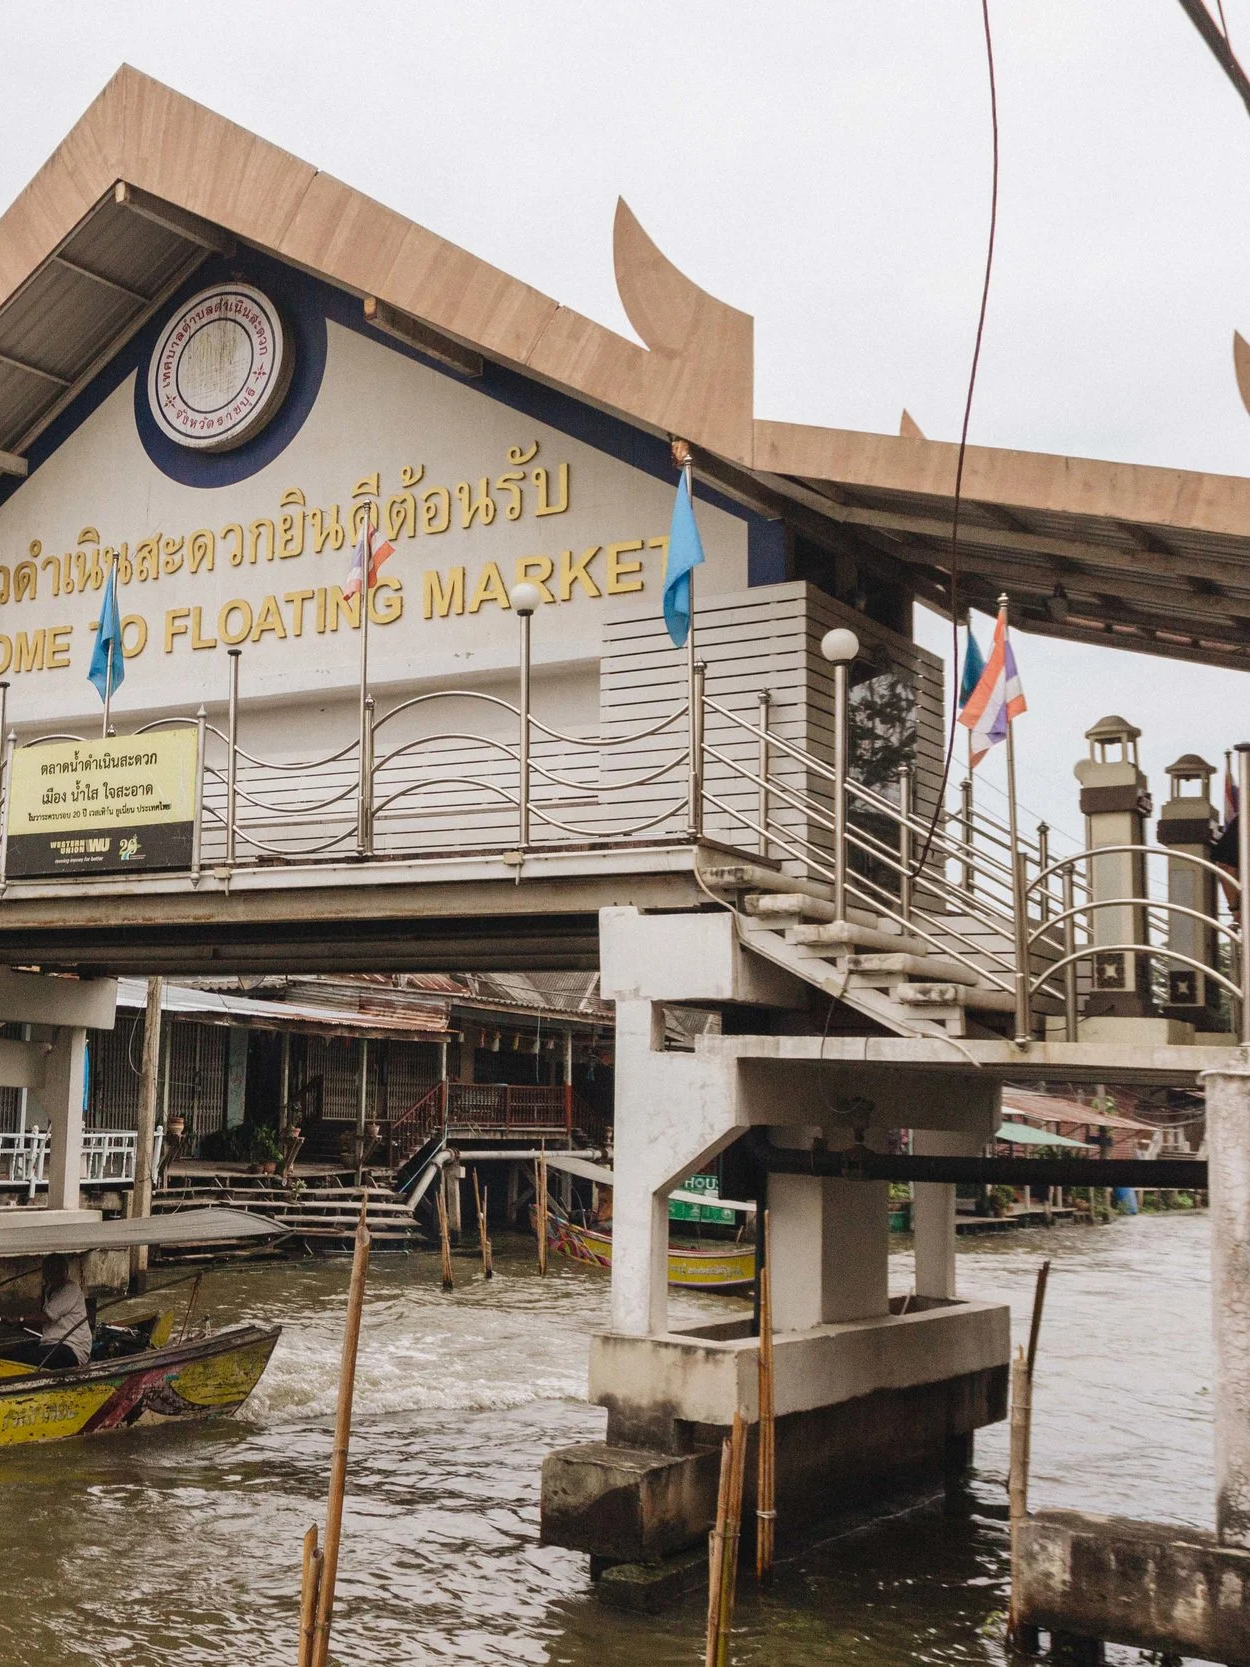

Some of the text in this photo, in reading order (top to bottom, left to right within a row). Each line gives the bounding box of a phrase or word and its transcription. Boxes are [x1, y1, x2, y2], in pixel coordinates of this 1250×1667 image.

[163, 576, 404, 653] FLOATING
[40, 750, 157, 775] ตลาดน้ำดำเนินสะดวก
[41, 780, 154, 805] เมือง น้ำใส ใจสะอาด
[72, 811, 81, 819] 20
[50, 839, 86, 849] WESTERN
[60, 846, 86, 855] UNION
